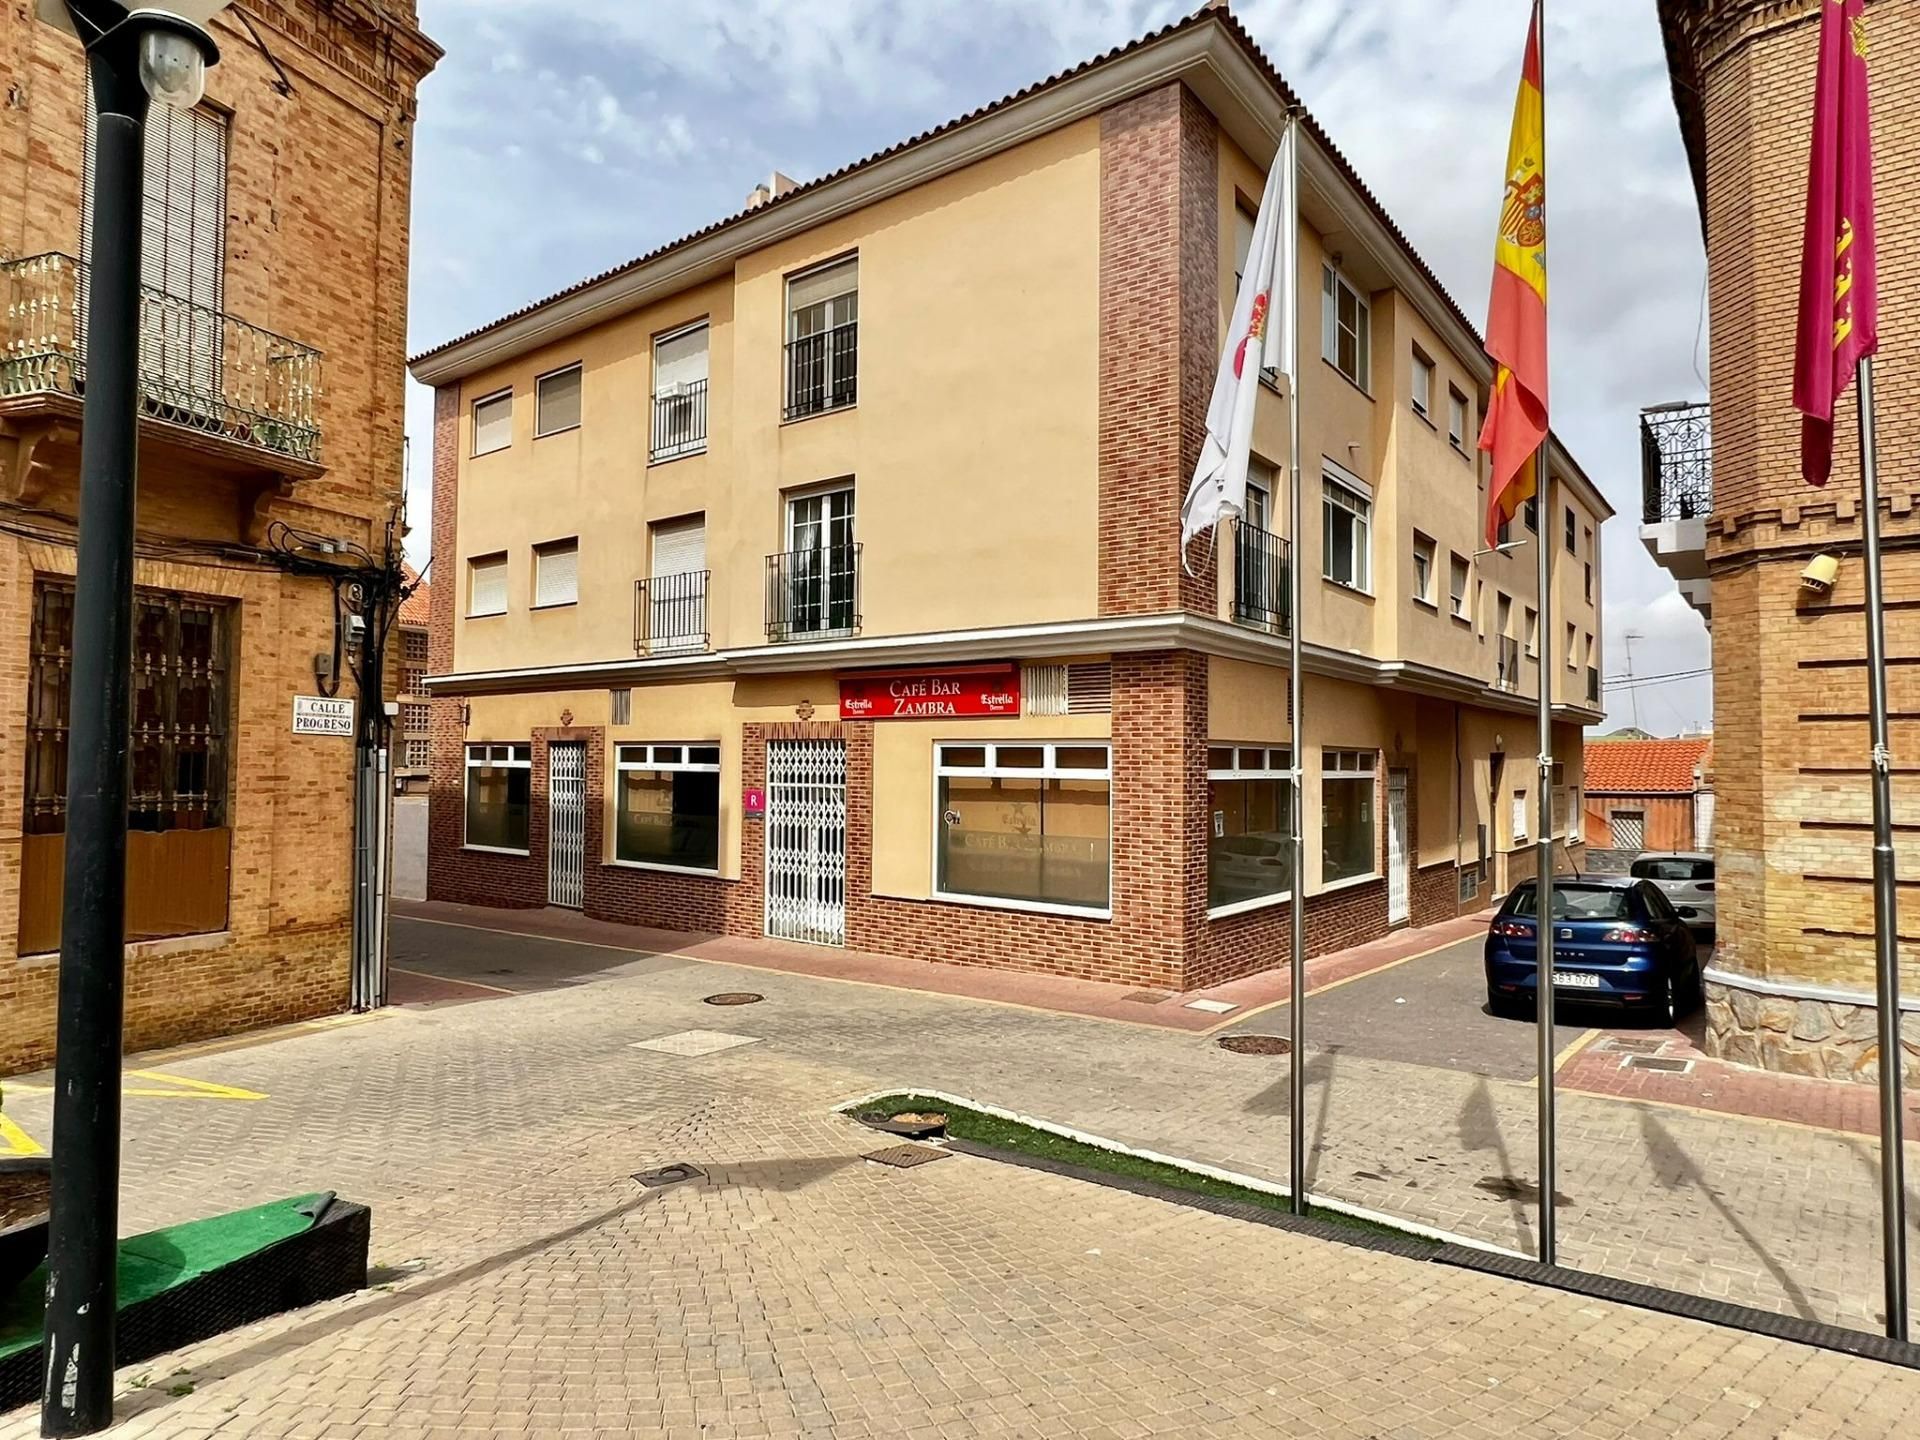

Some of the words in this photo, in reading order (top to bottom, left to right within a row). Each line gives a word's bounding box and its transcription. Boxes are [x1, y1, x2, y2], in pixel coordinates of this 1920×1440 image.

[889, 679, 927, 698] CAFÉ
[931, 678, 961, 696] BAR
[845, 698, 873, 709] Estrella
[980, 693, 1014, 704] Estrella
[310, 701, 345, 714] CALLE
[893, 698, 956, 715] ZAMBRA
[296, 717, 351, 730] PROGRESO
[750, 794, 758, 806] R
